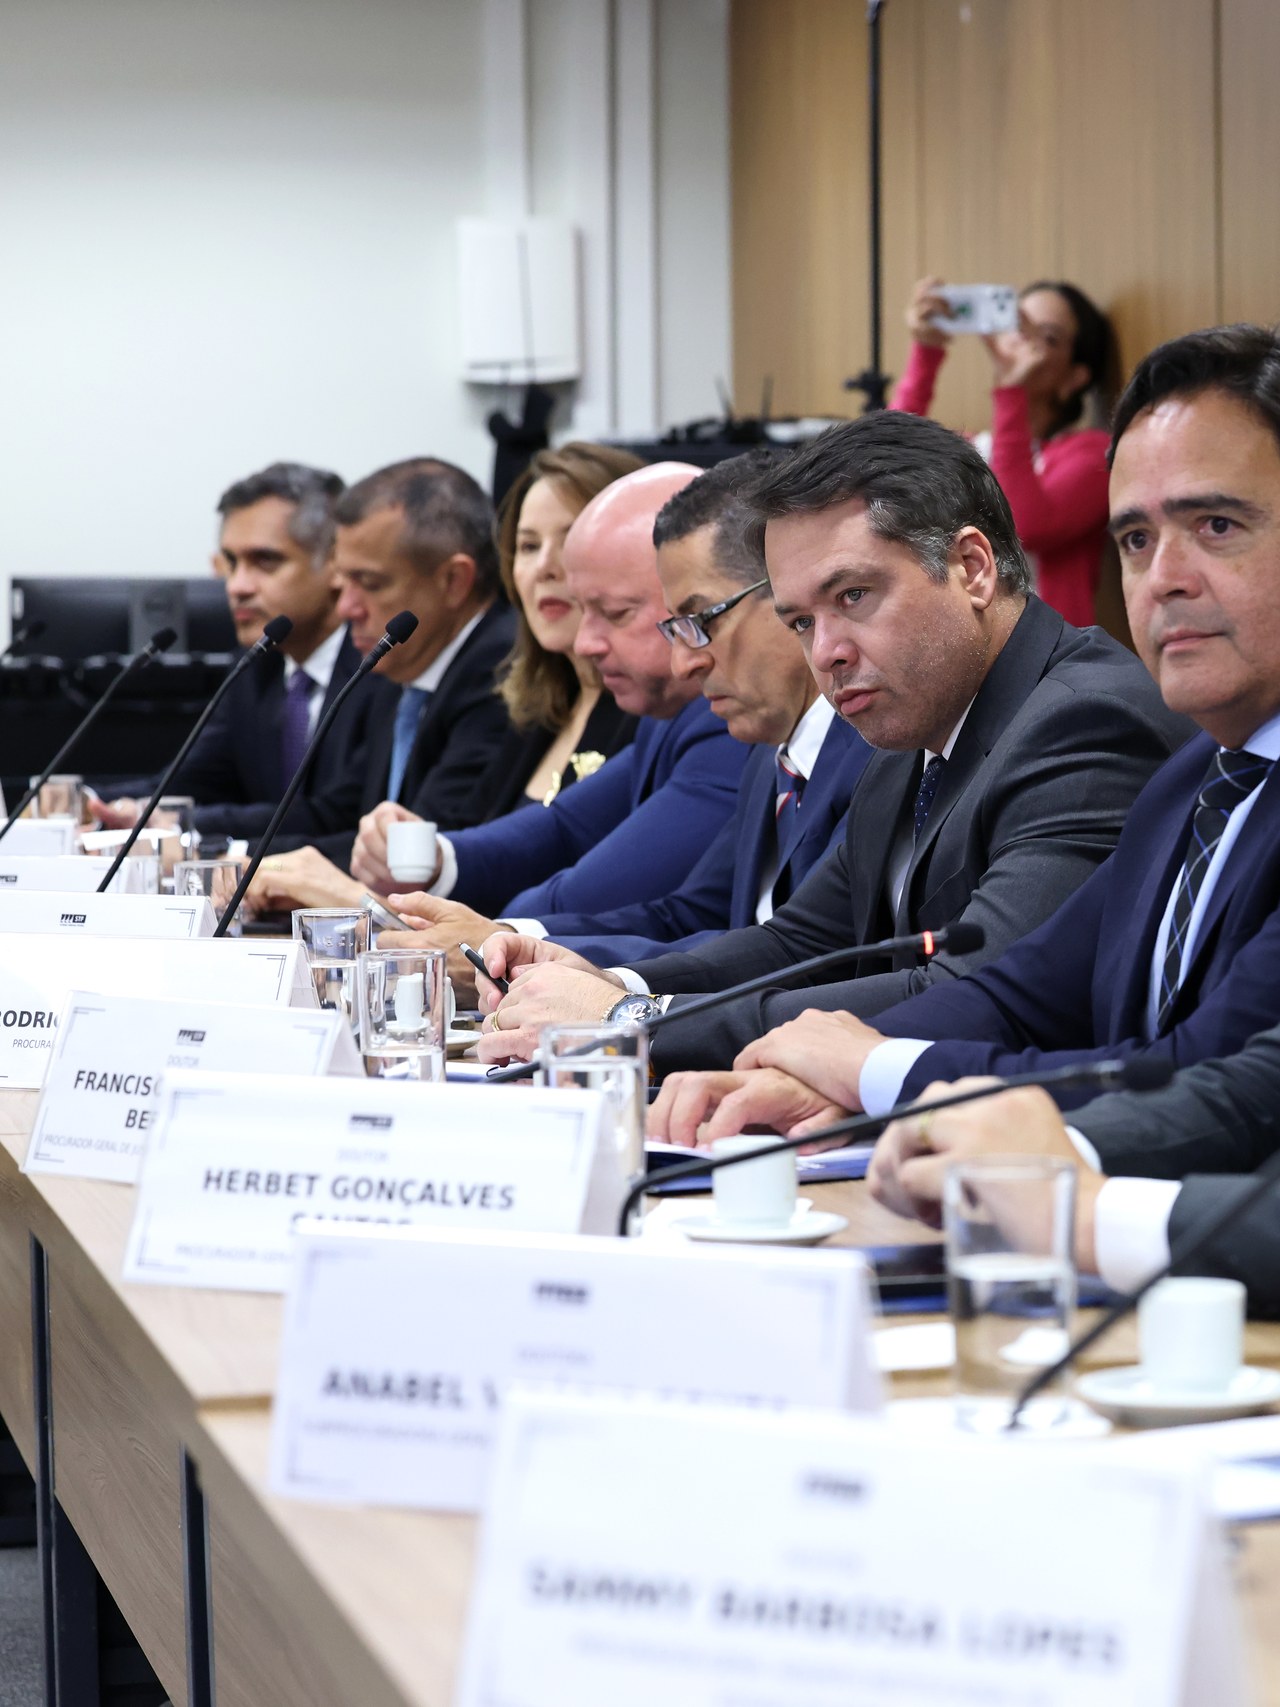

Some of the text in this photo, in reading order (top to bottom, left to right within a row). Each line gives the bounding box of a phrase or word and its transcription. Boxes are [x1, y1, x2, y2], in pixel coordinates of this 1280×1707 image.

[0, 1010, 58, 1028] ODRI
[203, 1167, 516, 1210] HERBET GONÇALVES
